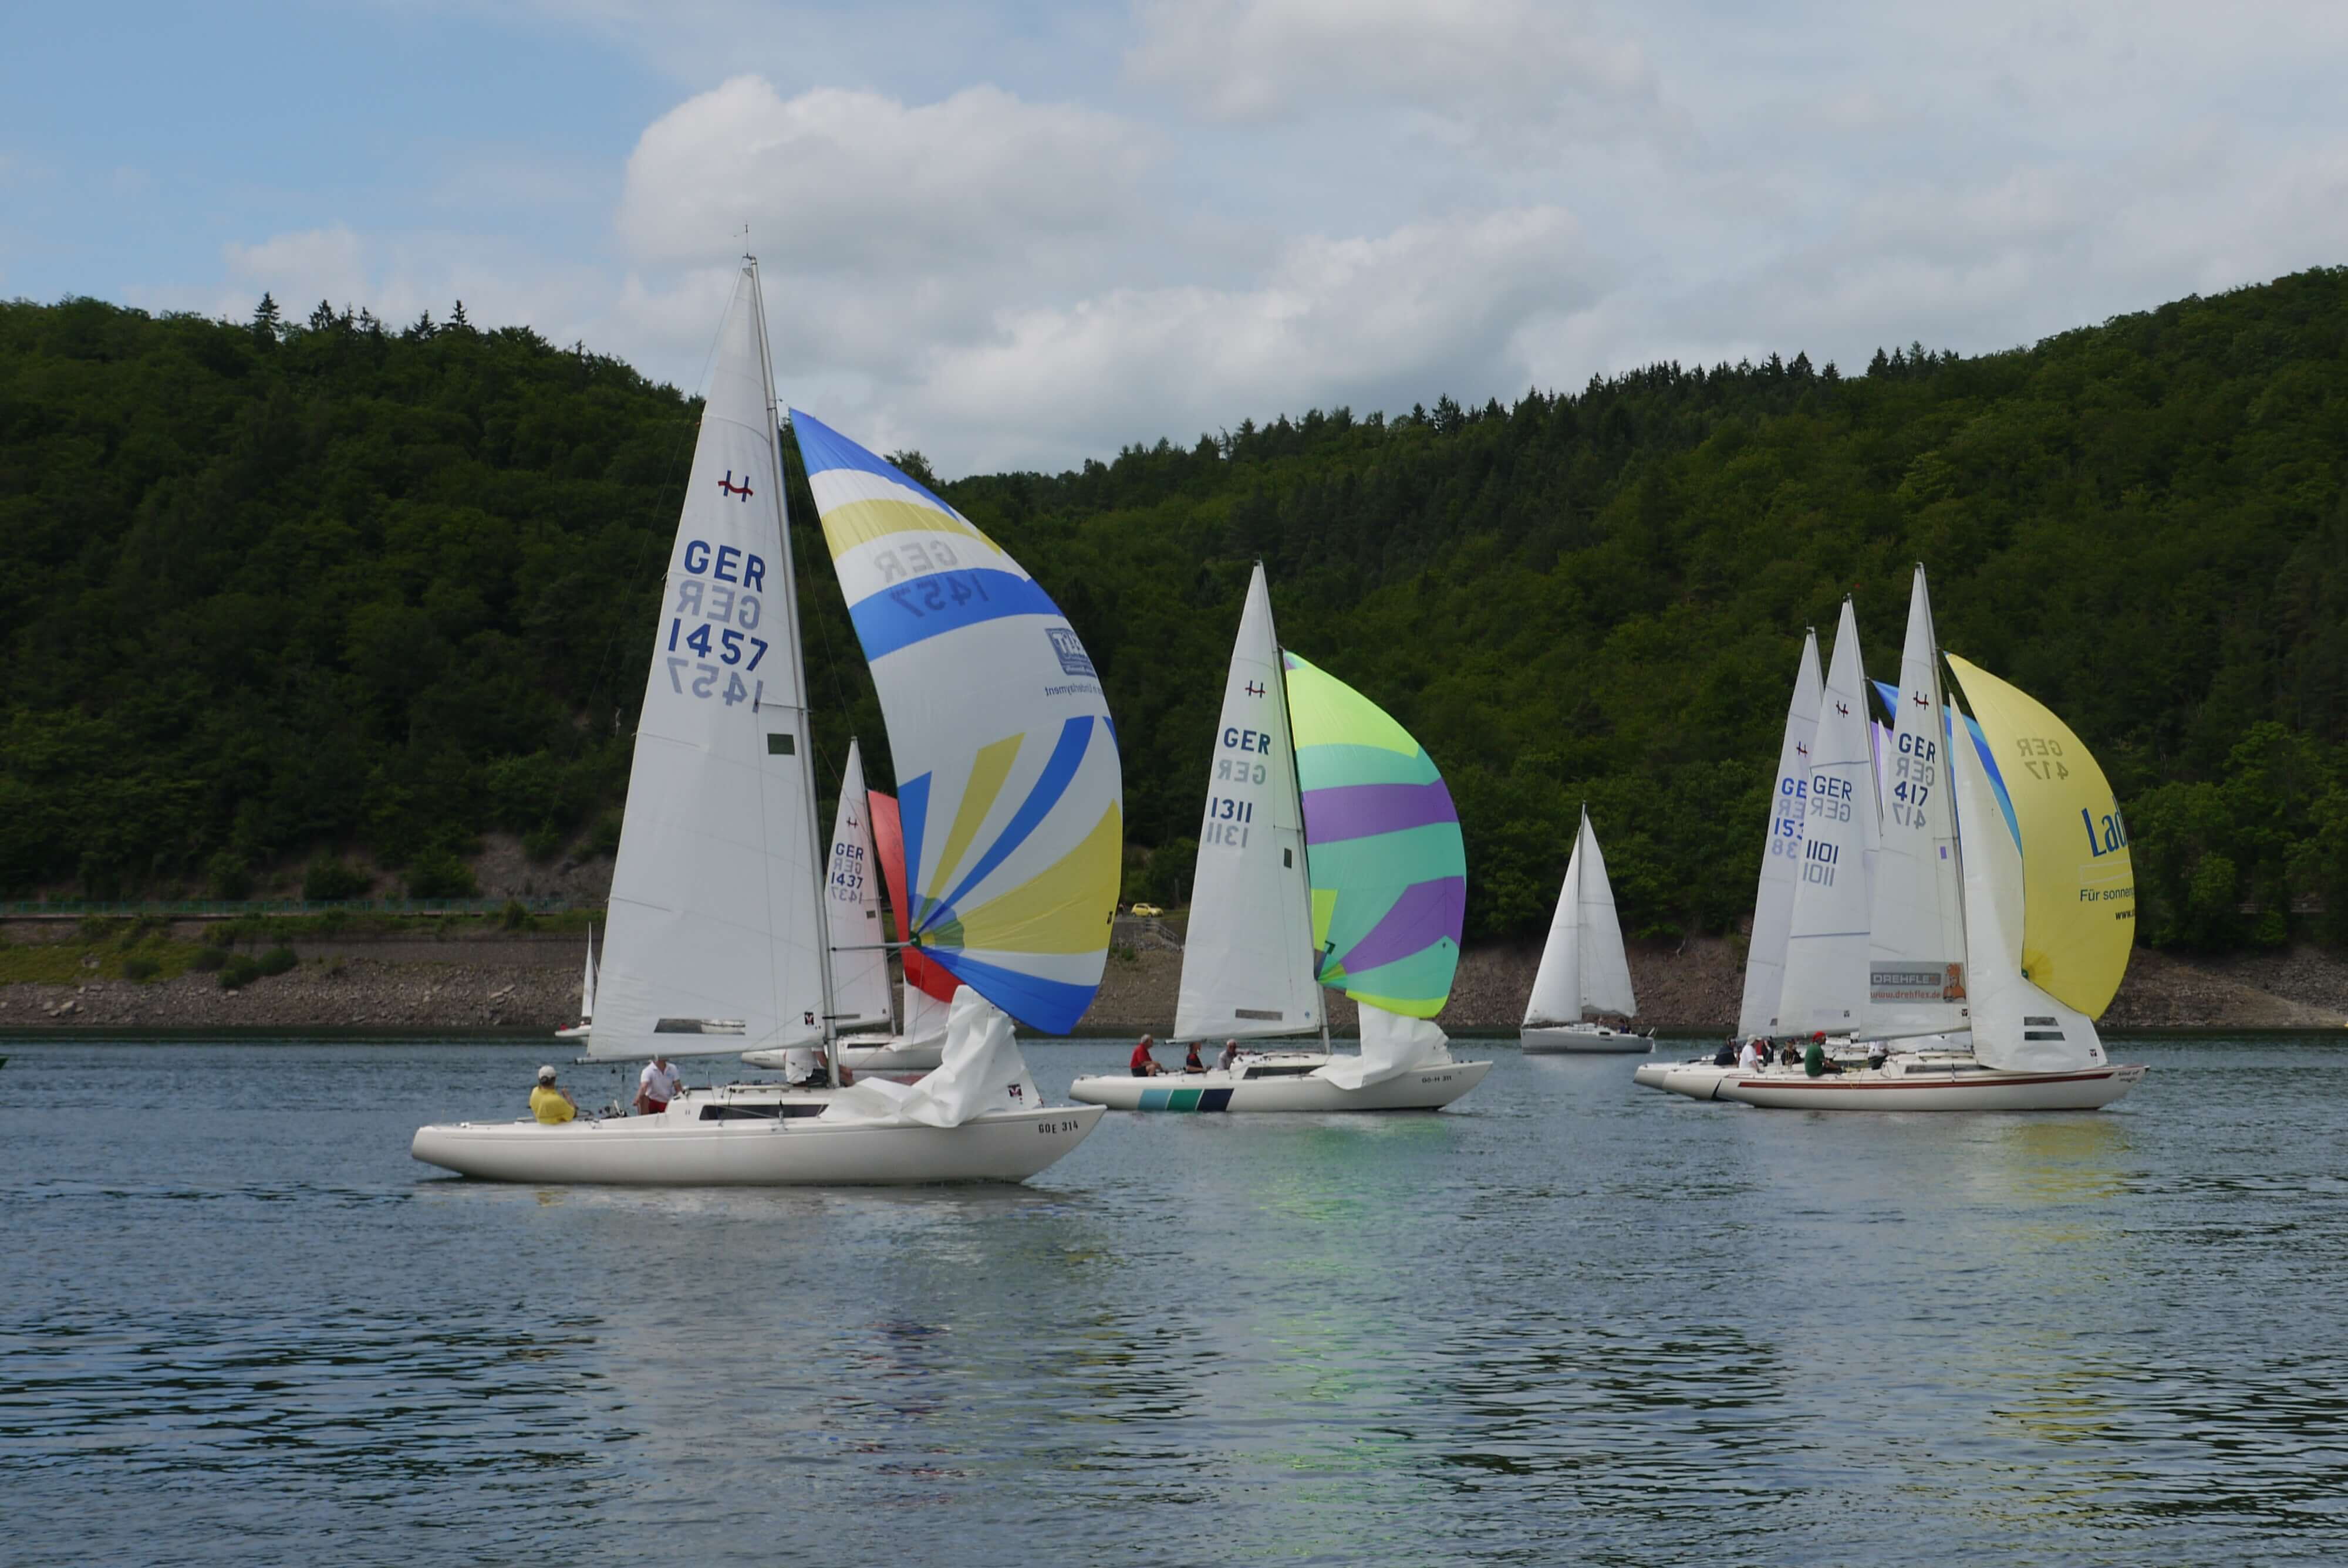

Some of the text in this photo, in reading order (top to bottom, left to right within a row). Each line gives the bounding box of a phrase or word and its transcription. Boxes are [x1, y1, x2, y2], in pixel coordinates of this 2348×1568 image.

[684, 540, 765, 593] GER
[668, 618, 768, 672] 1457
[1224, 727, 1271, 756] GER
[1898, 732, 1936, 763] GER
[1782, 778, 1807, 799] GE
[1813, 775, 1852, 802] GER
[1894, 780, 1928, 806] 417
[1211, 797, 1252, 823] 1311
[836, 842, 863, 861] GER
[1806, 839, 1838, 864] 1101
[831, 871, 863, 889] 1437
[2080, 888, 2100, 901] Für
[1062, 1120, 1078, 1131] 314
